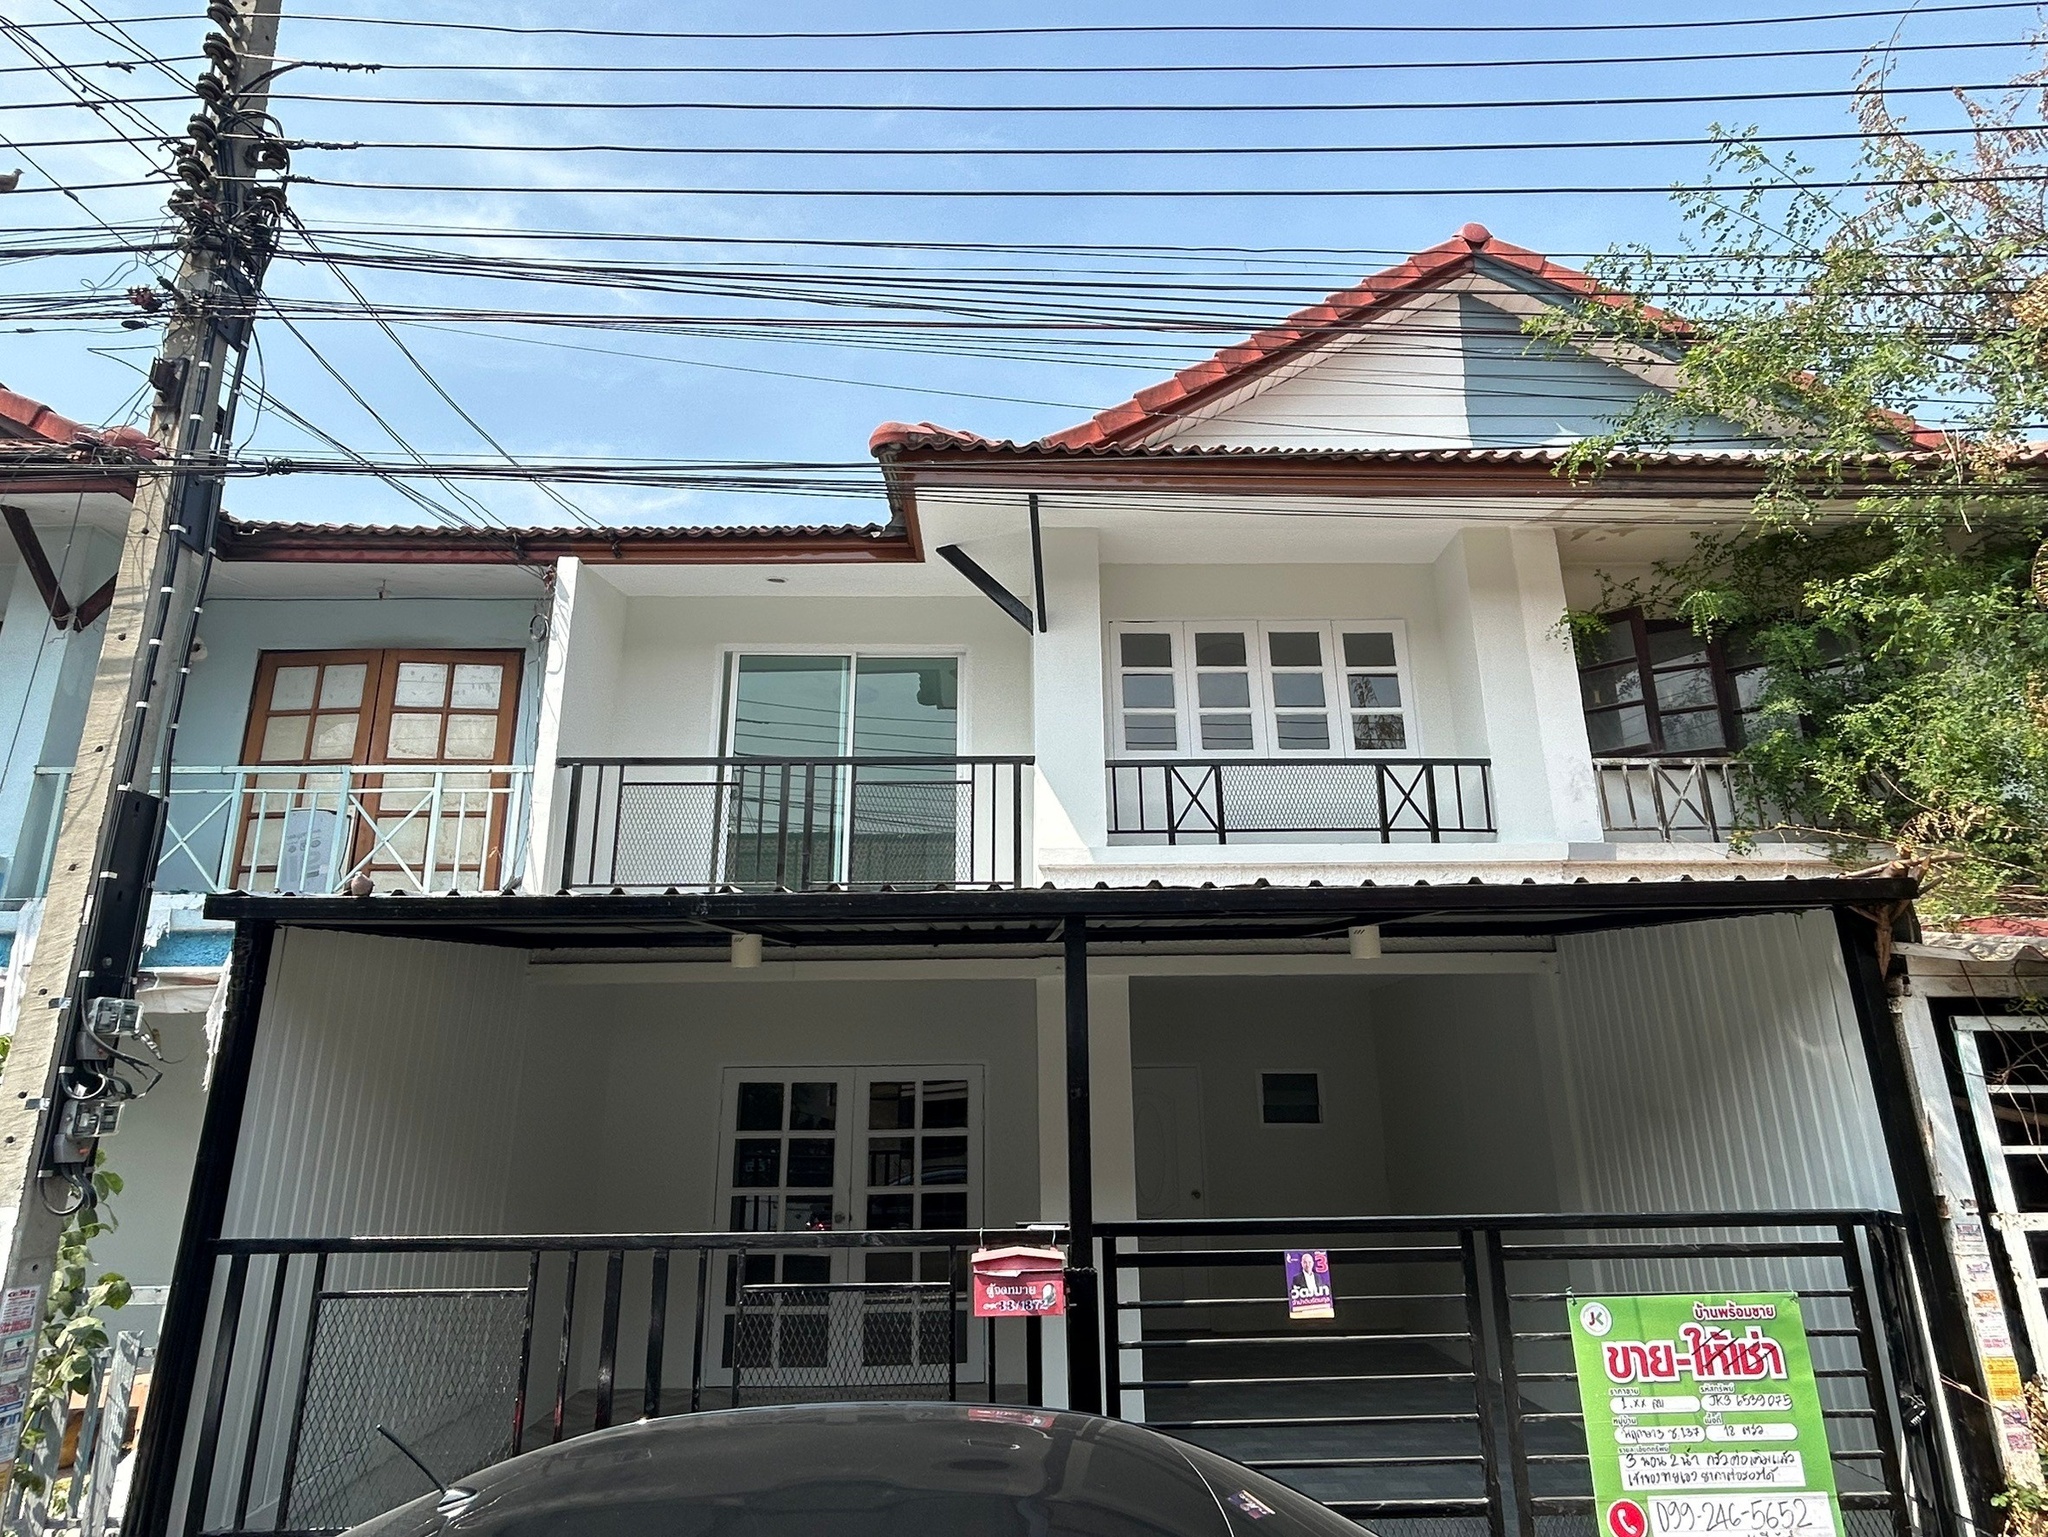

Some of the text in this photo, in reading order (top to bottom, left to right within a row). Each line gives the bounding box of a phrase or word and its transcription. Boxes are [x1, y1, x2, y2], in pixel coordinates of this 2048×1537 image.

[1314, 1254, 1329, 1273] 3
[986, 1282, 1037, 1299] ตู้จดหมาย
[1588, 1311, 1604, 1326] JK
[1695, 1303, 1775, 1319] บ้านพร้อมขาย
[1610, 1388, 1639, 1396] ราคาขาย
[1613, 1415, 1637, 1427] หมู่บ้าน
[1625, 1453, 1637, 1469] 3
[1669, 1453, 1680, 1467] 2
[1656, 1498, 1813, 1533] 099-246-5652
